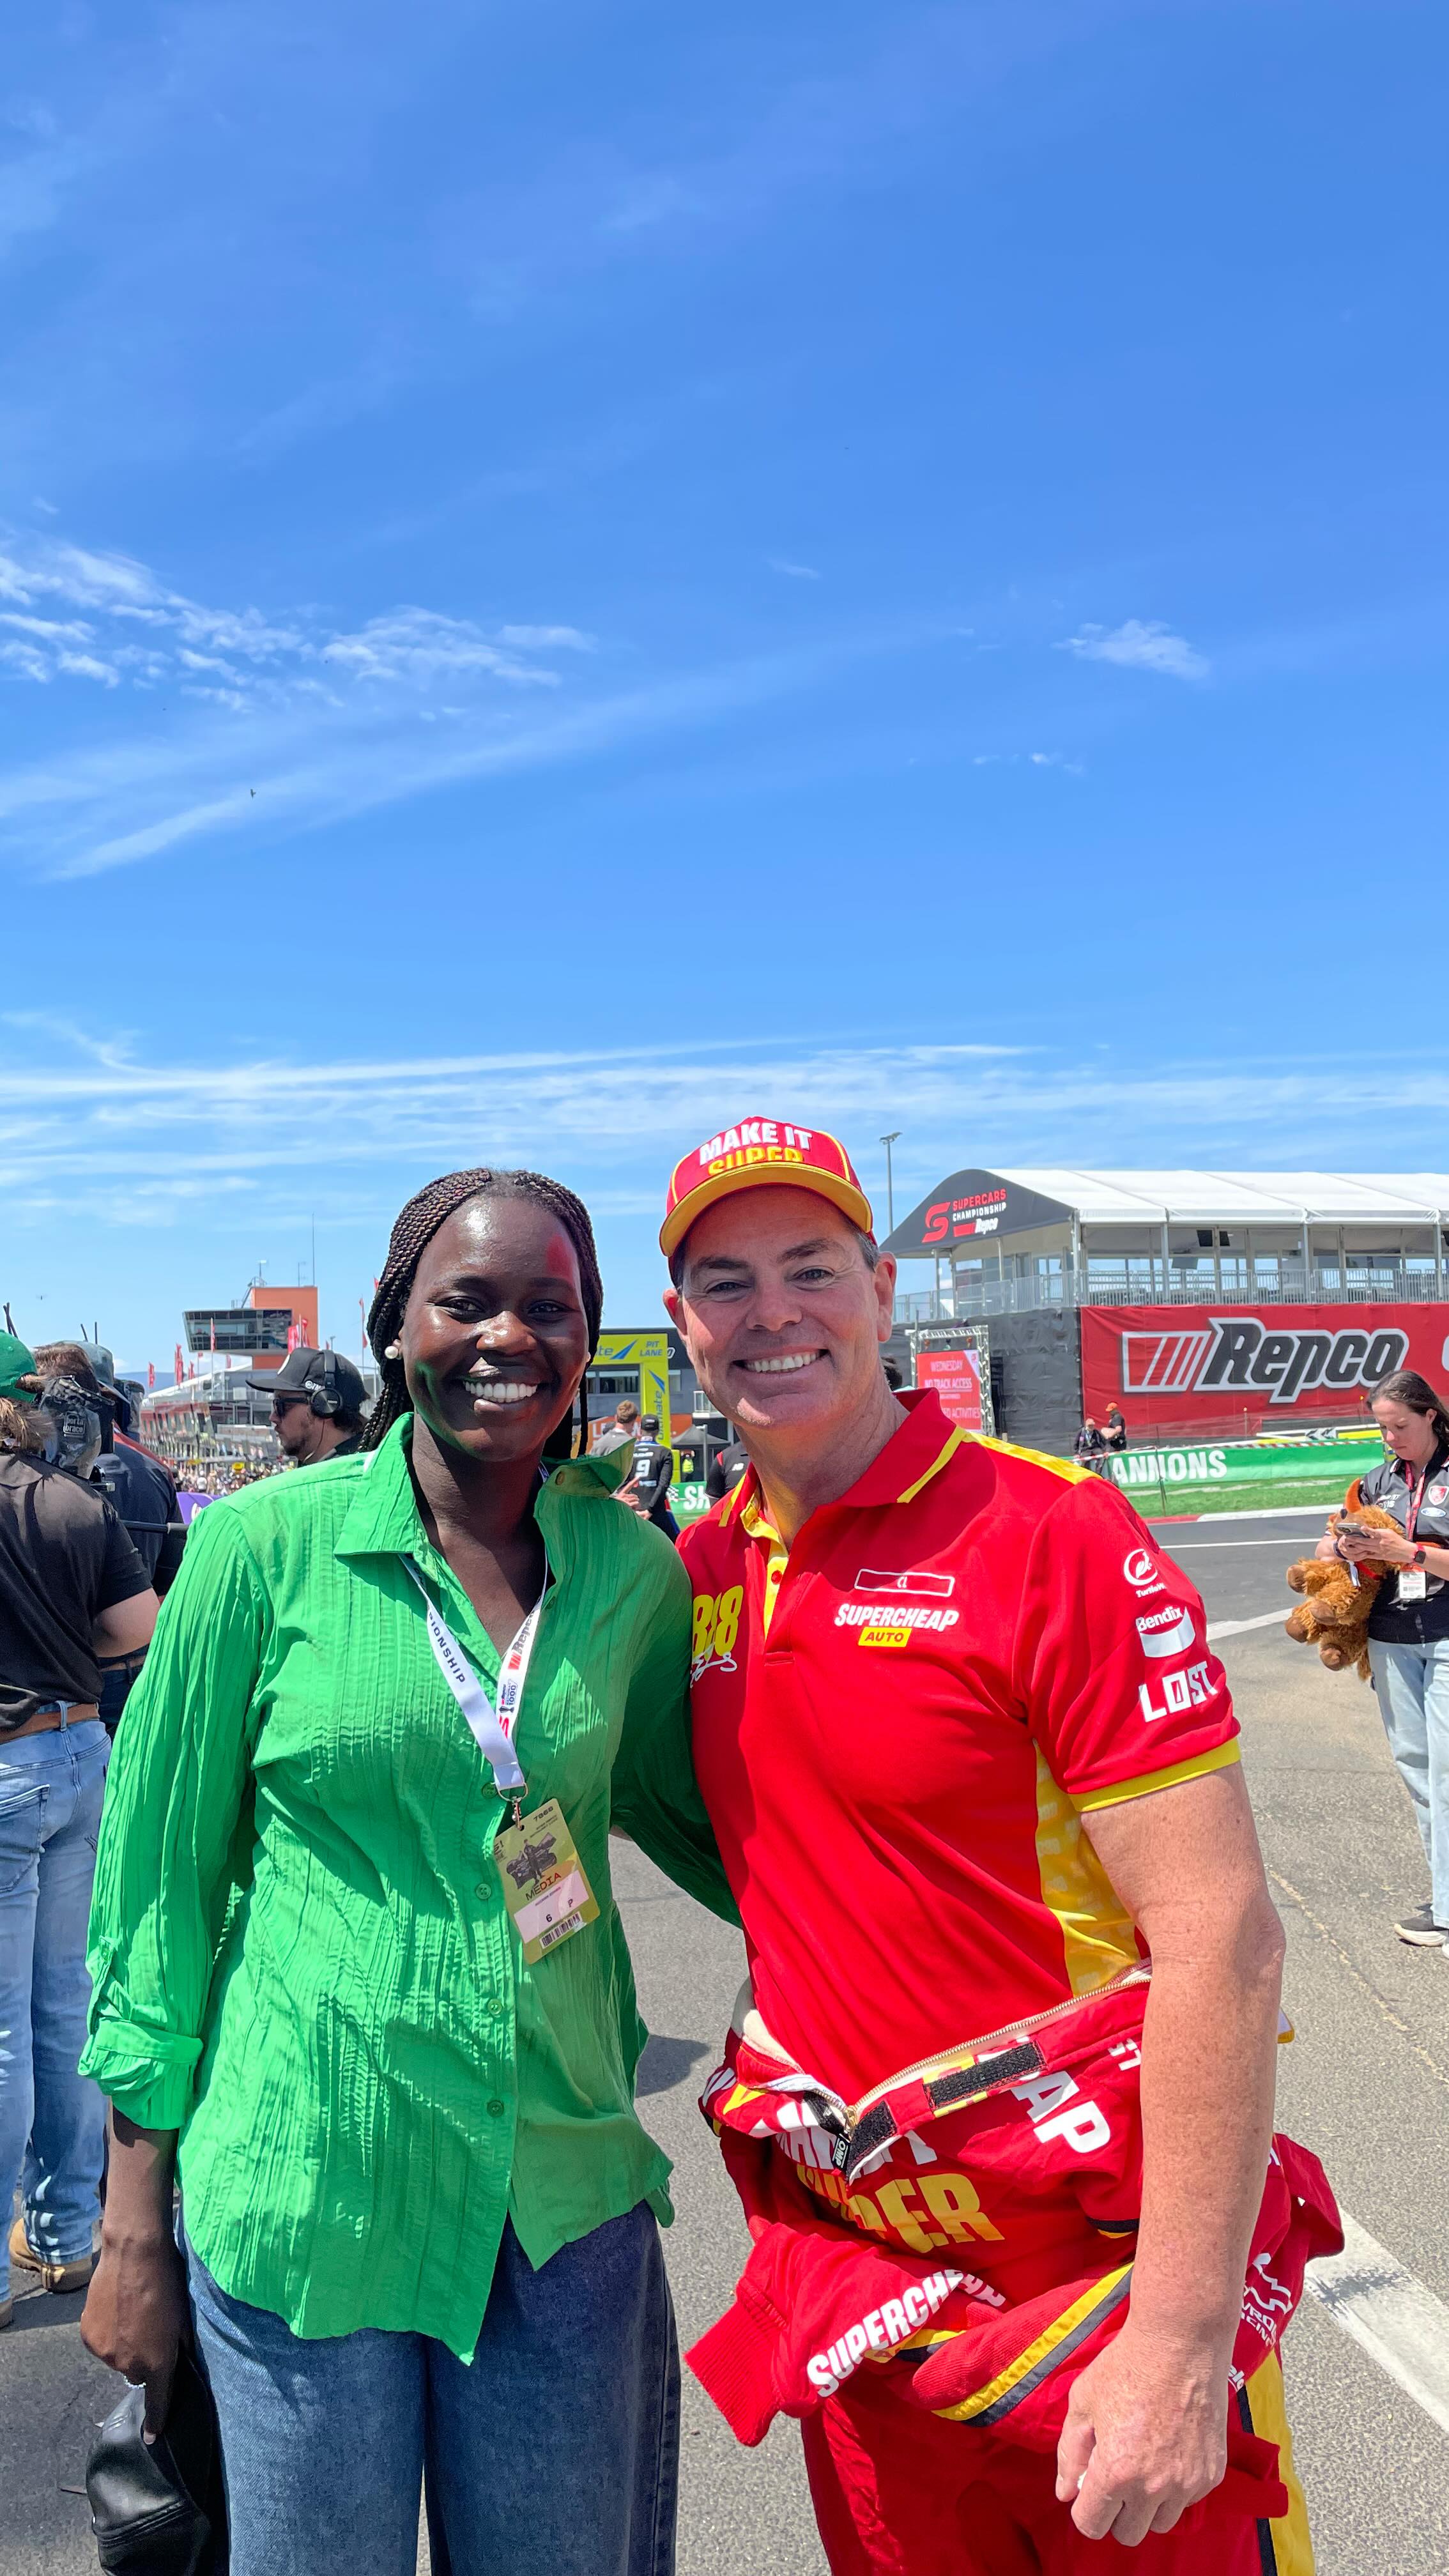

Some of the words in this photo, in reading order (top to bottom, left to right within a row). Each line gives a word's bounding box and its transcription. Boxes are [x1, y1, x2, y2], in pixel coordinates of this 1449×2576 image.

[700, 1122, 779, 1165] MAKE
[784, 1126, 813, 1151] IT
[953, 1188, 1007, 1211] SUPERCARS
[953, 1202, 1007, 1222] CHAMPIONSHIP
[640, 1349, 663, 1357] LANE
[1195, 1317, 1408, 1403] Repco
[635, 1459, 650, 1476] 9
[1112, 1450, 1228, 1484] ANNONS
[834, 1603, 959, 1632] SUPERCHEAP
[1135, 1606, 1184, 1633] Bendix
[864, 1632, 905, 1643] AUTO
[1138, 1660, 1218, 1723] LOST
[525, 1872, 562, 1901] MEDIA
[546, 1913, 553, 1922] 6
[835, 2140, 846, 2167] OMP
